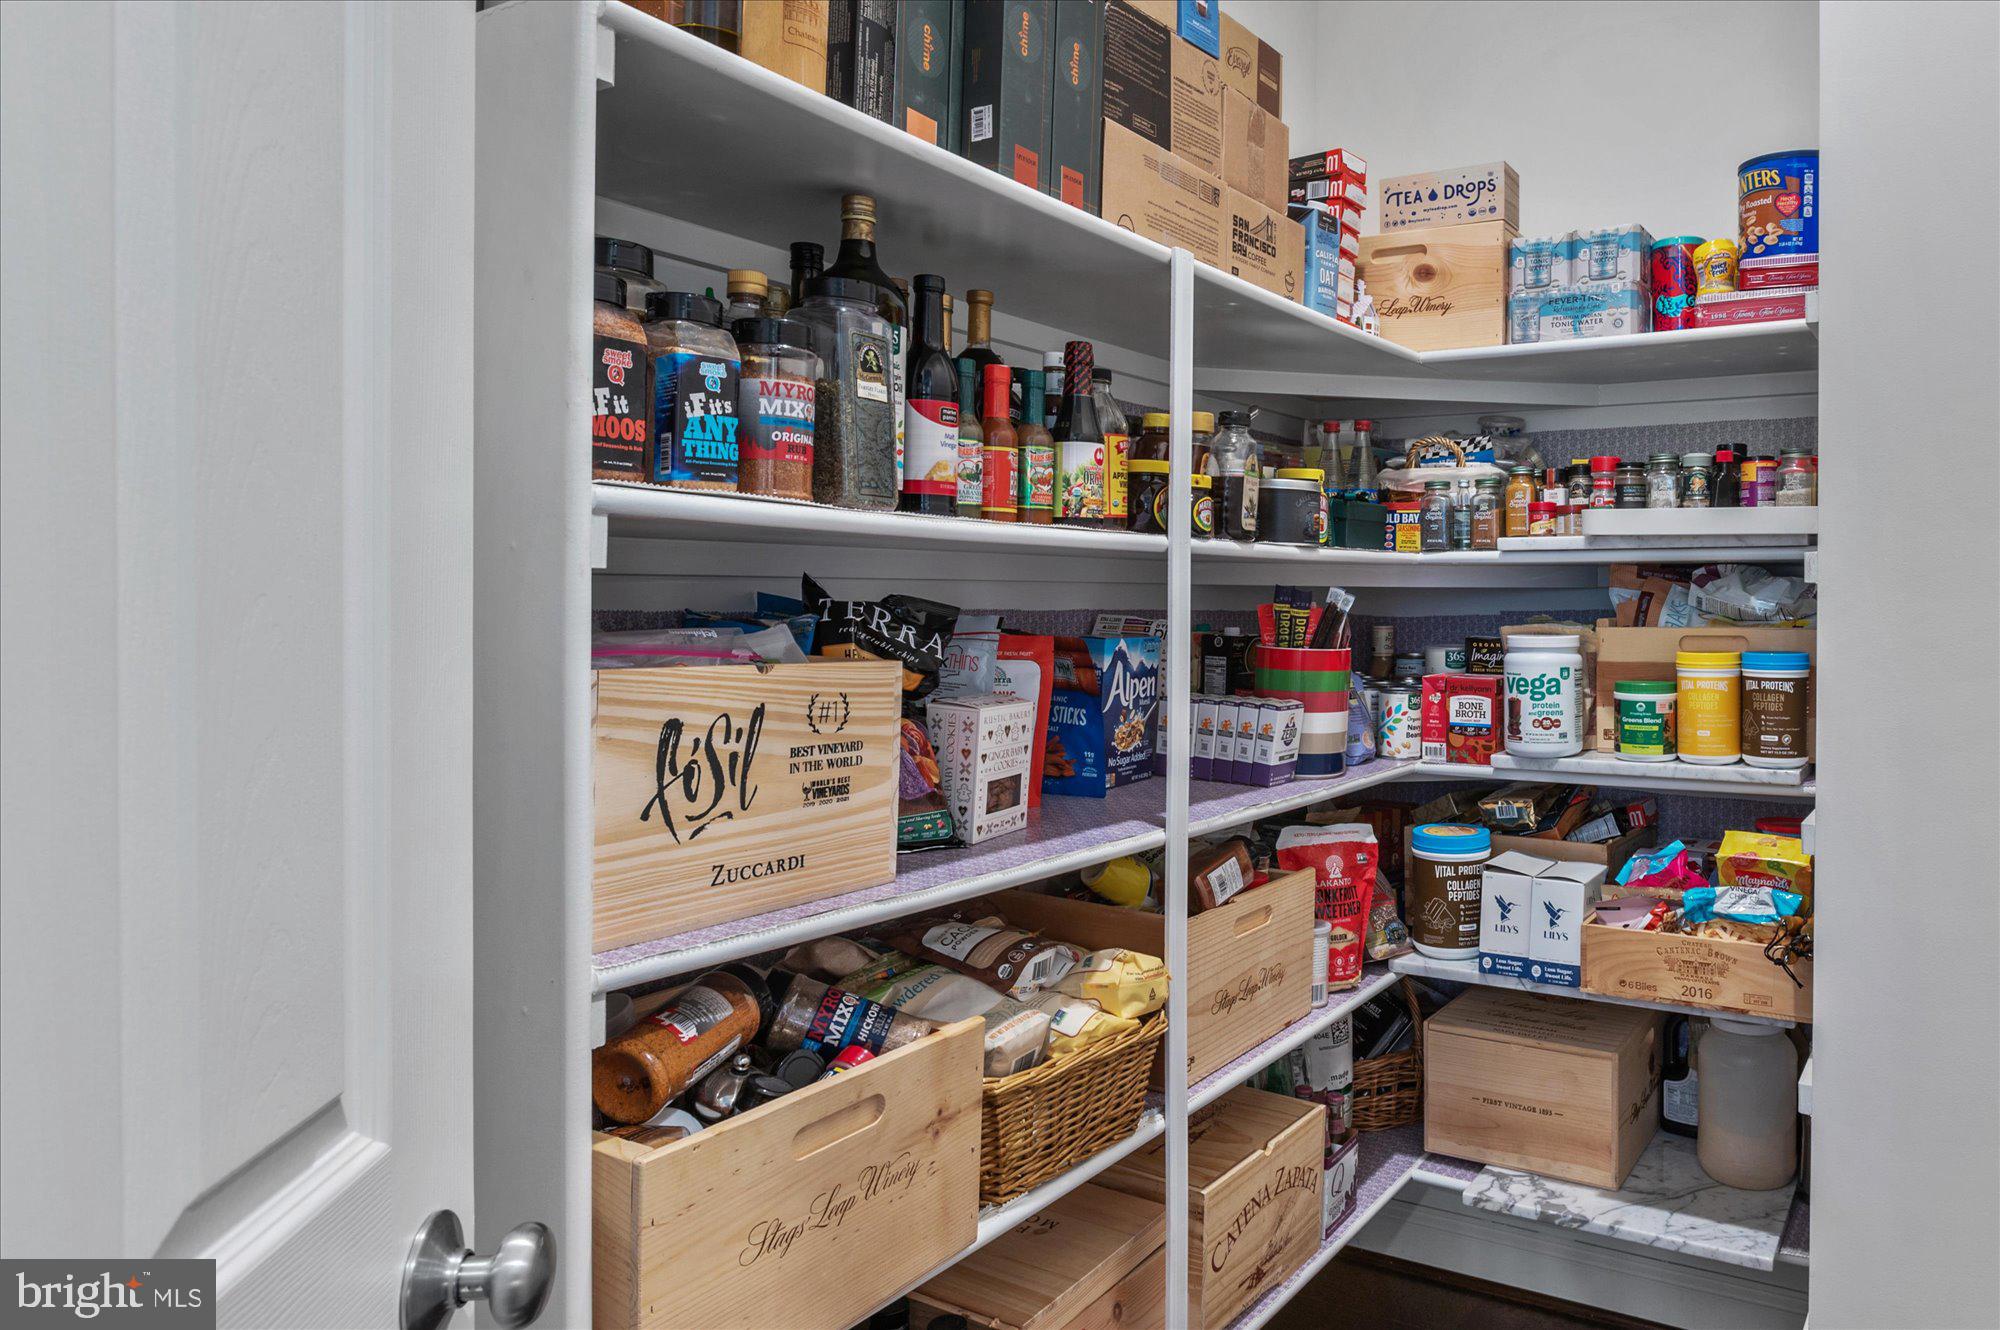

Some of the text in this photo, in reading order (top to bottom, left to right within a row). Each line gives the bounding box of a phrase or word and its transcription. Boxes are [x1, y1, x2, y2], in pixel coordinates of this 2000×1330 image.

[1386, 179, 1496, 207] TEA DROPS
[1232, 214, 1250, 232] SAN
[1232, 228, 1277, 258] FRANCISCO
[1232, 241, 1267, 267] BAY COFFEE
[1710, 260, 1728, 272] JUICY
[1711, 267, 1729, 278] FRUIT
[1319, 269, 1335, 286] OAT
[1408, 295, 1455, 317] Winery
[1551, 318, 1604, 329] TONIC WATER
[759, 381, 815, 402] MYRO
[613, 395, 630, 415] it
[709, 398, 733, 415] it's
[759, 398, 815, 423] MIXO
[683, 413, 739, 443] ANY
[682, 439, 739, 462] THING
[787, 443, 807, 455] RUB
[1401, 513, 1420, 524] BAY
[818, 597, 944, 661] TERRA
[858, 631, 895, 653] egetable
[895, 649, 919, 664] chips
[1447, 652, 1466, 662] 365
[1102, 660, 1156, 714] Alpen
[1506, 673, 1562, 702] vega
[1681, 679, 1729, 692] VITAL PROTEINS
[1745, 680, 1794, 693] VITAL PROTEINS
[1688, 692, 1720, 702] COLLAGEN
[1752, 692, 1785, 703] COLLAGEN
[818, 701, 839, 724] #1
[1458, 701, 1484, 711] BONE
[1532, 702, 1561, 710] protein
[1688, 701, 1719, 711] PEPTIDES
[1753, 701, 1784, 712] PEPTIDES
[1052, 706, 1087, 726] STICKS
[1455, 709, 1487, 719] BROTH
[1537, 710, 1564, 718] greens
[1621, 716, 1643, 724] Greens
[947, 712, 958, 764] COOKIES
[790, 740, 864, 759] BEST VINEYARD
[790, 755, 863, 775] IN THE WORLD
[1108, 757, 1117, 768] No
[1116, 755, 1131, 767] Sugar
[837, 776, 851, 784] BEST
[811, 783, 851, 800] VINEYARDS
[836, 796, 850, 804] 2021
[1435, 864, 1457, 879] VITAL
[1446, 878, 1482, 893] COLLAGEN
[1736, 875, 1790, 891] Maynards
[1448, 889, 1481, 903] PEPTIDES
[1494, 924, 1520, 936] LILY'S
[1543, 930, 1569, 942] LILY'S
[1330, 934, 1348, 942] GOLDEN
[1681, 939, 1713, 949] CHATEAU
[1707, 949, 1739, 966] BROWN
[1544, 966, 1558, 974] Less
[1627, 981, 1634, 989] 6
[1681, 986, 1713, 1000] 2016
[806, 987, 843, 1042] MYRO
[1369, 1003, 1383, 1015] BEST
[823, 992, 861, 1047] MIXO
[1482, 1096, 1502, 1108] FIRST
[1503, 1100, 1538, 1115] VINTAGE
[808, 1184, 857, 1230] Leap
[857, 1151, 926, 1202] Winery
[1210, 1183, 1271, 1275] CATENA
[1274, 1165, 1319, 1198] ZAPATA
